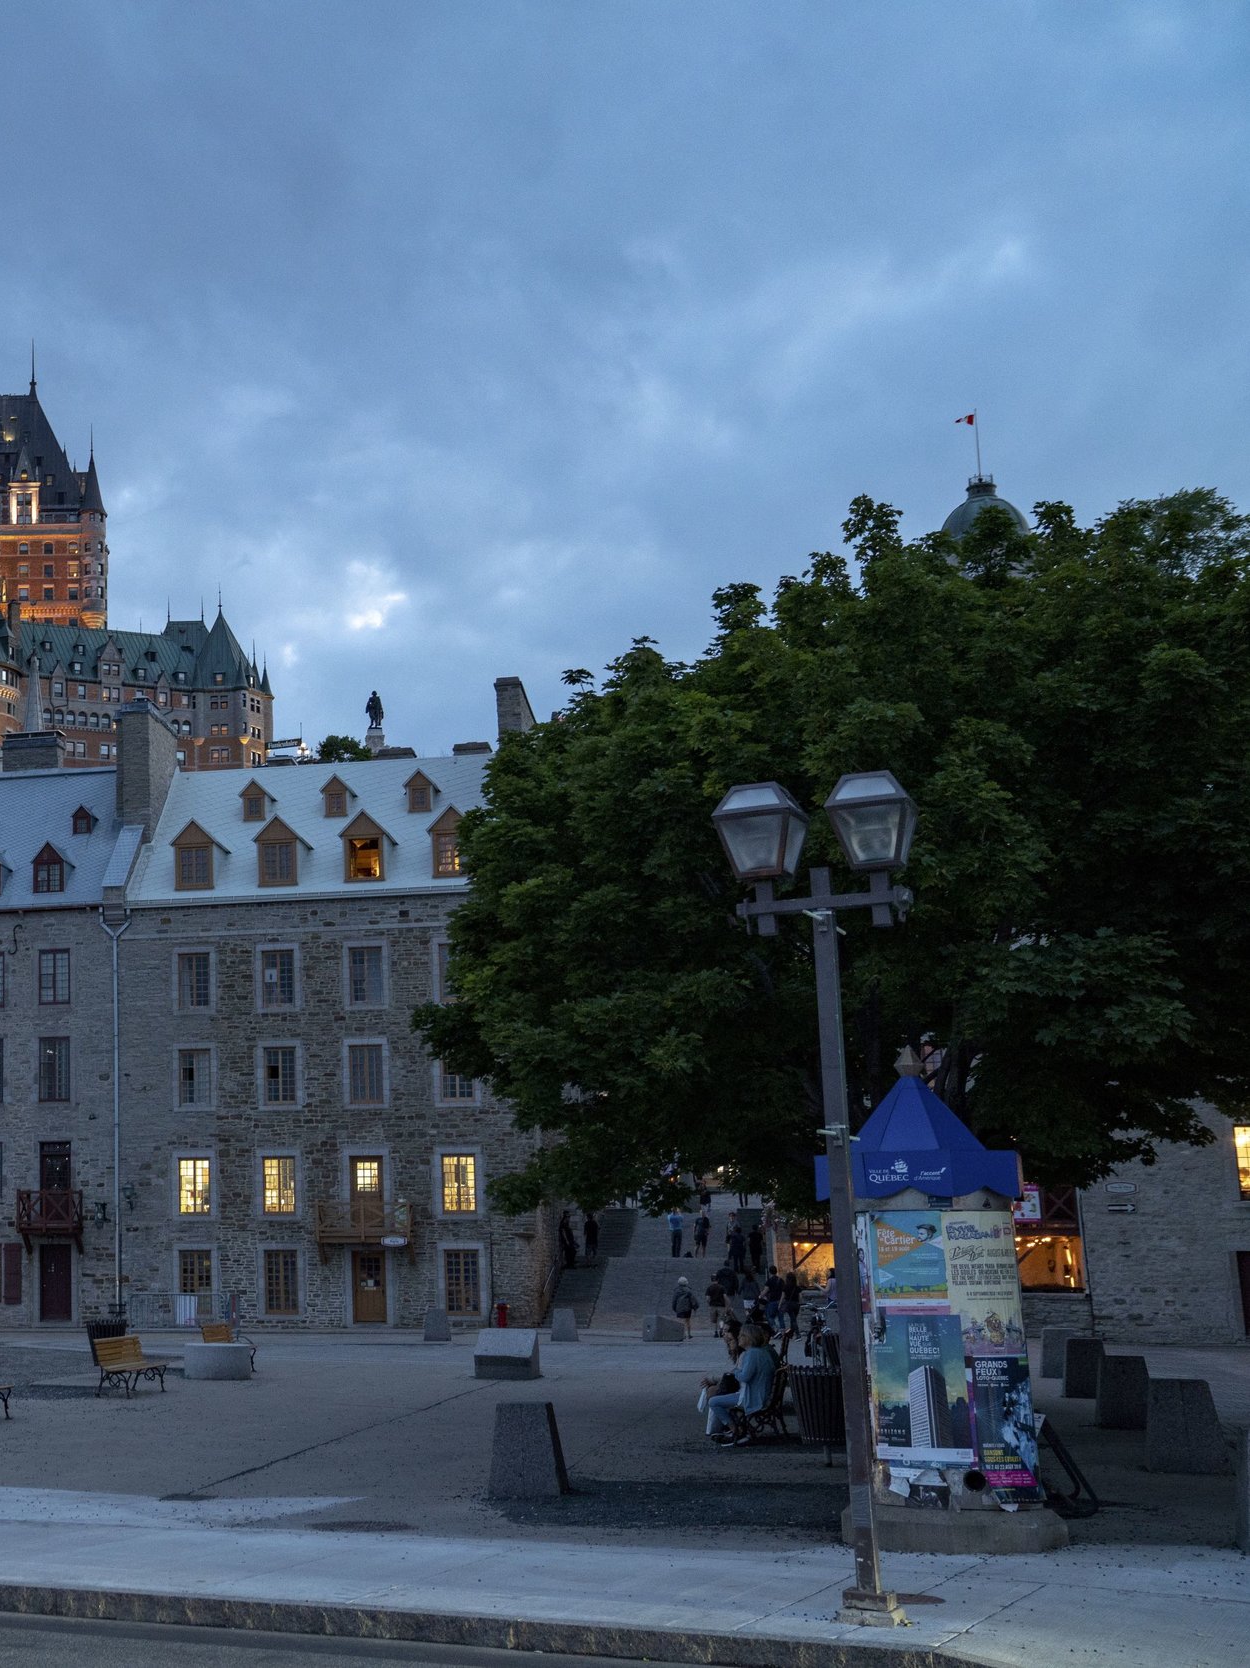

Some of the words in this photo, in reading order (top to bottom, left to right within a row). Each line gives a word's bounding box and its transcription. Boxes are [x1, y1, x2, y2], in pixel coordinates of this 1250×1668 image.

[869, 1173, 910, 1184] QUÉBEC
[877, 1228, 895, 1238] Fête
[884, 1235, 916, 1245] Cartier
[910, 1346, 940, 1354] QUÉBEC!
[975, 1360, 1008, 1368] GRANDS
[975, 1368, 998, 1376] FEUX
